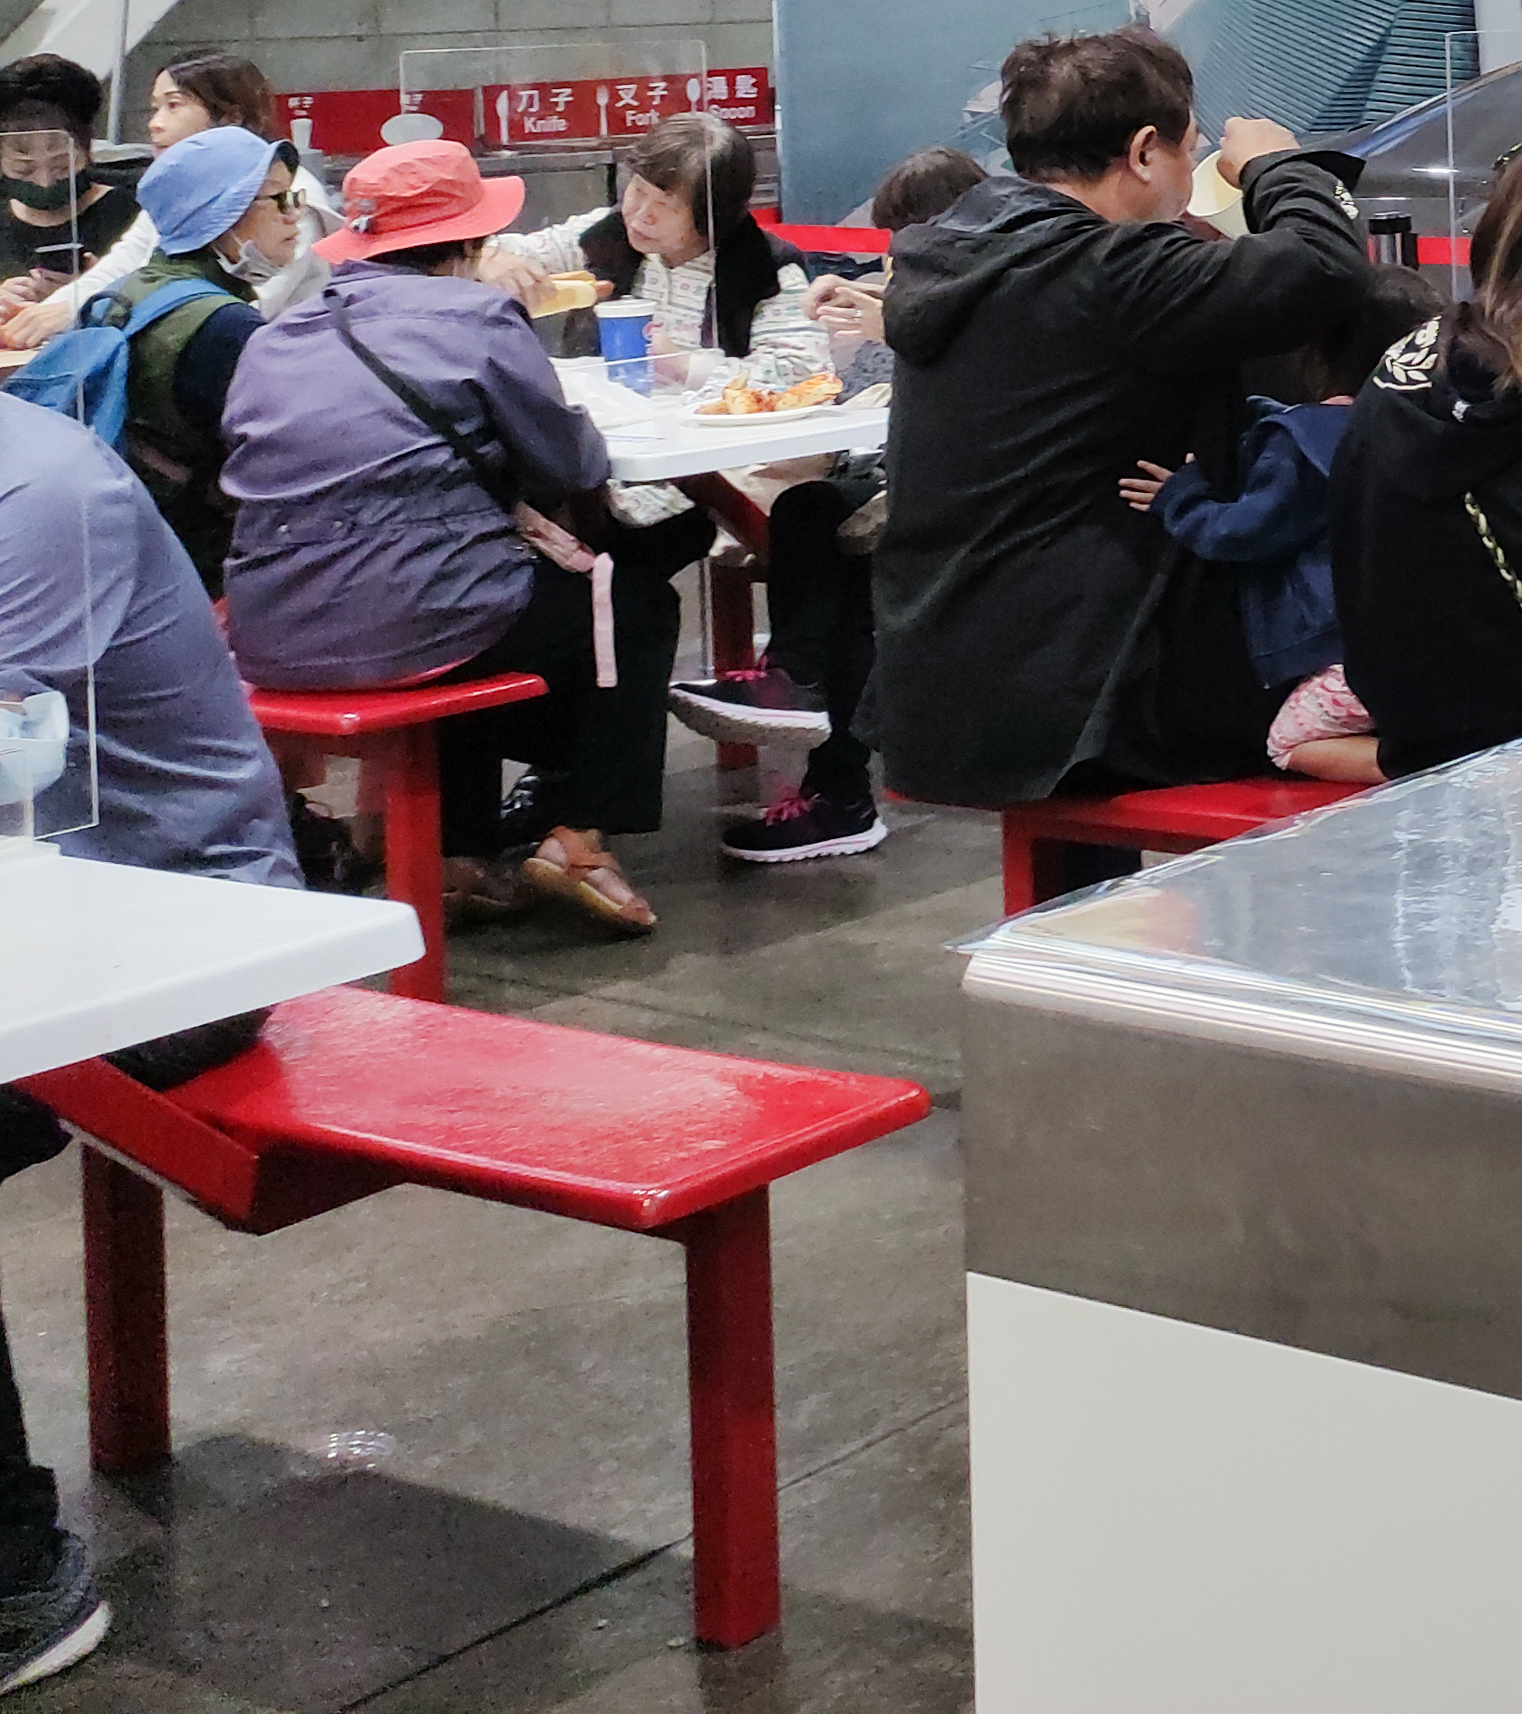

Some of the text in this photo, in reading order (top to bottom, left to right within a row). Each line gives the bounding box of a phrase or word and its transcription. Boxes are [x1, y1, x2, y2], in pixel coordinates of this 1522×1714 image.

[516, 87, 576, 115] 刀子
[614, 80, 669, 108] 叉子
[625, 108, 661, 128] Fork
[709, 103, 756, 122] Spoon
[524, 114, 569, 135] Knife
